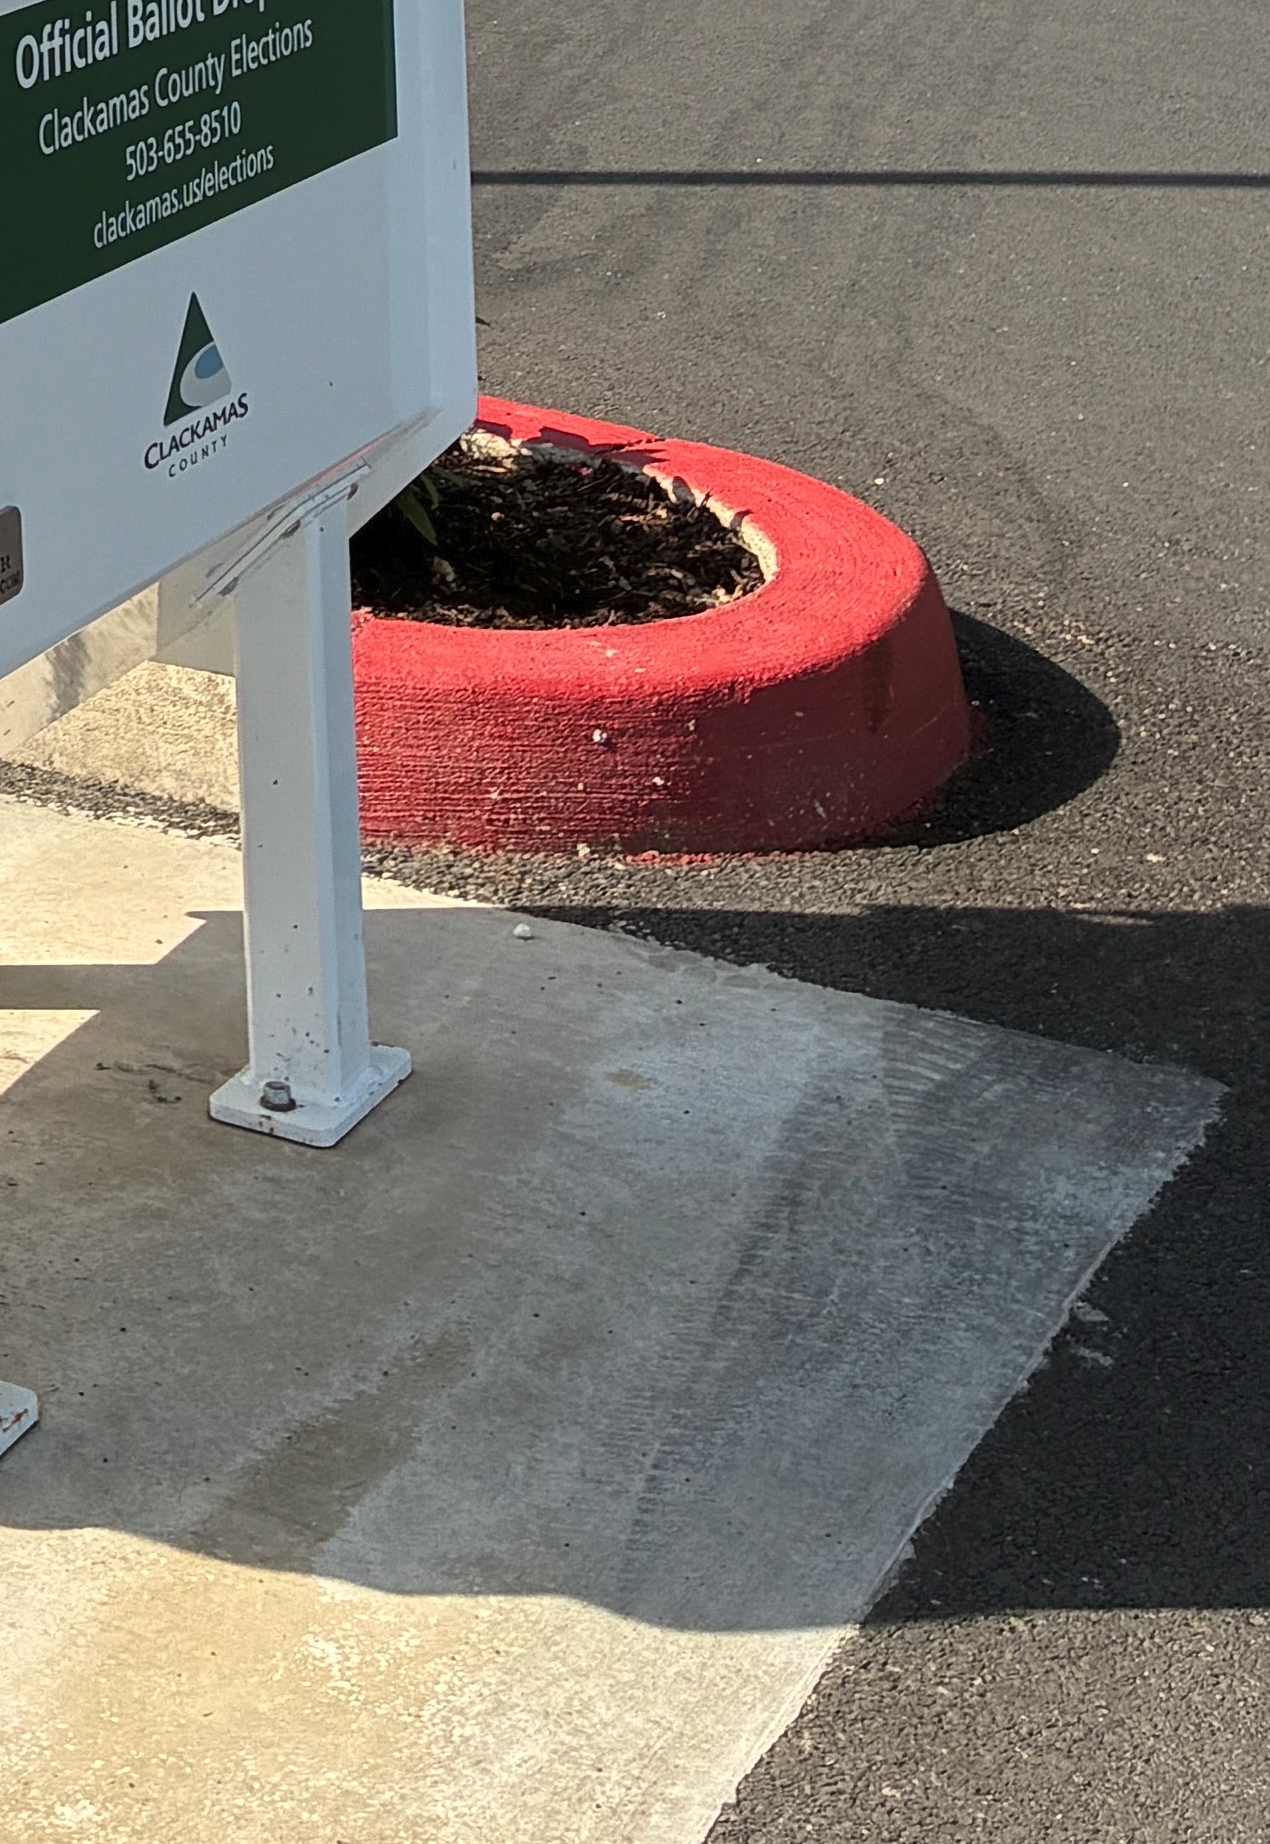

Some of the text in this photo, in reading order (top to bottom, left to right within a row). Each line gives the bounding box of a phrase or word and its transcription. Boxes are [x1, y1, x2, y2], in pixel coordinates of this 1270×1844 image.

[15, 0, 118, 90] Official
[38, 15, 314, 156] Clackamas County Elections
[125, 101, 242, 182] 503-655-8510
[93, 142, 275, 249] clackamas.us/elections
[143, 392, 250, 470] CLACKAMAS
[168, 434, 228, 478] COUNTY
